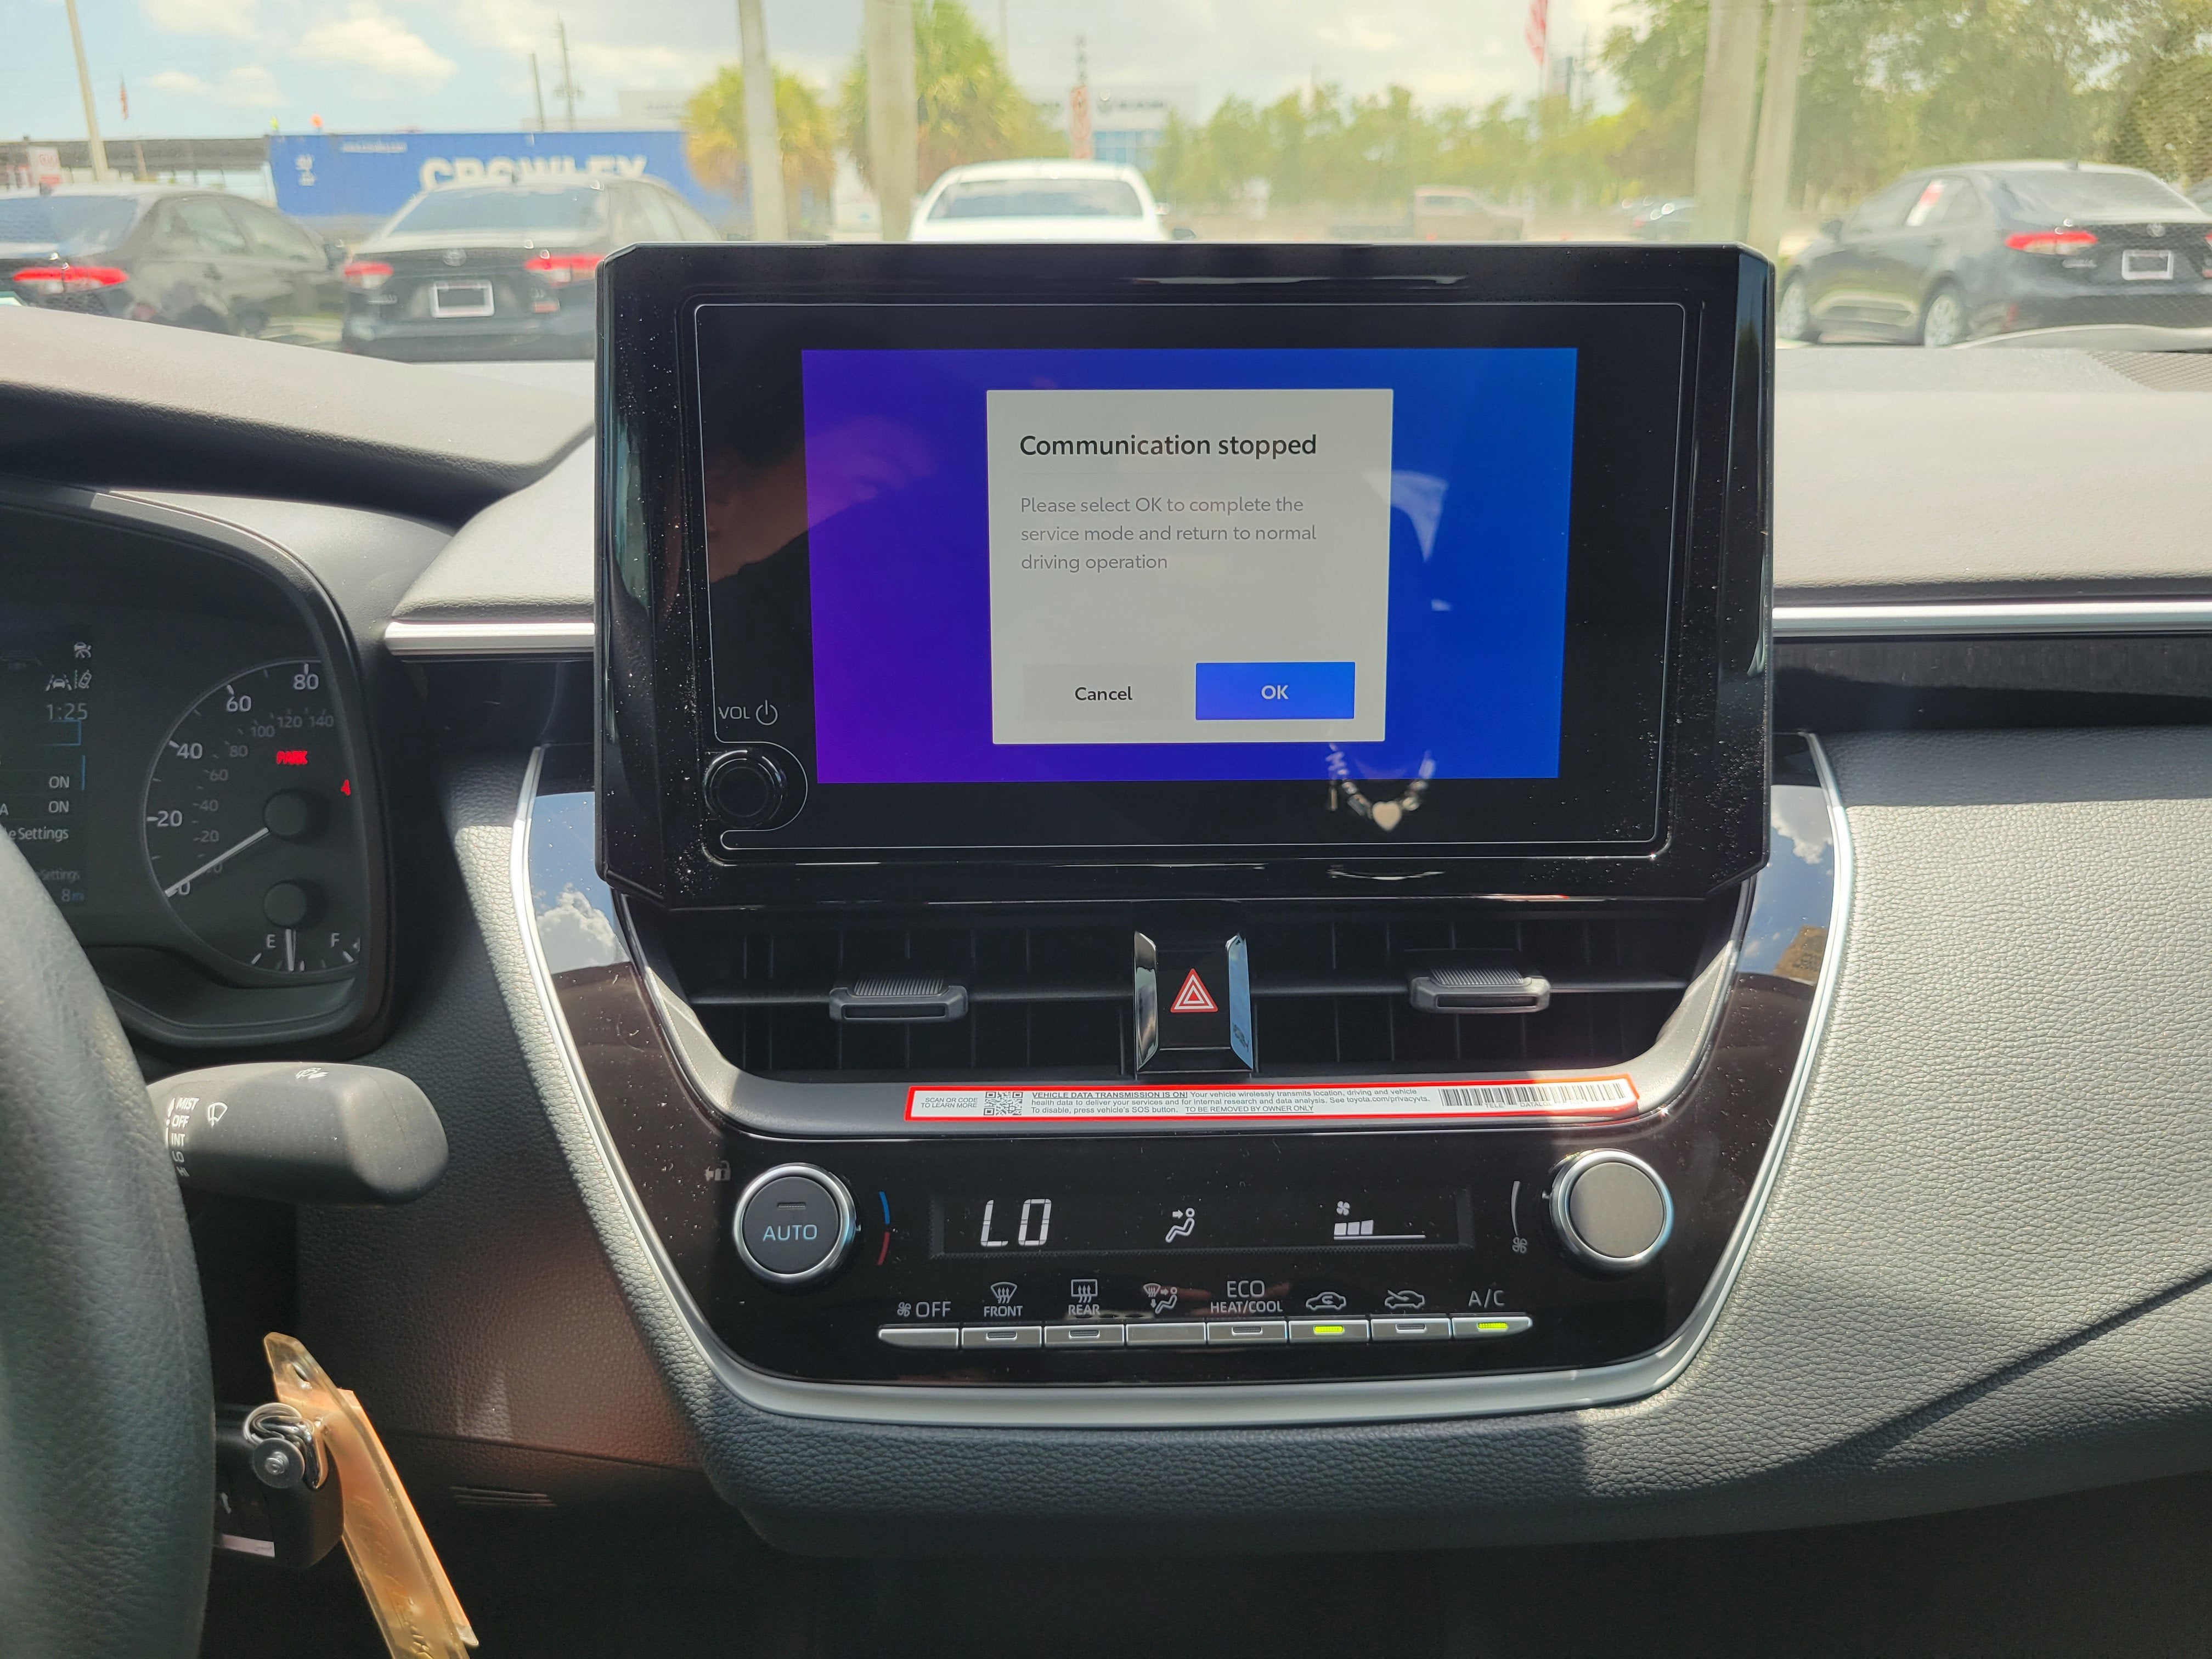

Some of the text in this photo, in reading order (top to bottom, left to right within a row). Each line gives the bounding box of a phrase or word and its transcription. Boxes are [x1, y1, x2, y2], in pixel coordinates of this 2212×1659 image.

[1020, 435, 1317, 460] Communication stopped
[1021, 496, 1304, 516] Please select OK to complete the
[1021, 525, 1317, 541] service mode and return to normal
[1022, 554, 1168, 573] driving operation
[293, 673, 319, 690] 80
[1074, 686, 1133, 702] Cancel
[1261, 685, 1289, 701] OK
[226, 695, 252, 712] 60
[47, 703, 88, 720] 1:25
[718, 706, 751, 719] VOL
[277, 715, 302, 729] 120
[309, 715, 335, 727] 140
[250, 725, 275, 738] 100
[176, 743, 203, 760] 40
[229, 744, 248, 758] 80
[276, 751, 308, 765] PARK
[48, 776, 70, 788] ON
[210, 769, 229, 782] 60
[48, 800, 70, 813] ON
[199, 799, 218, 812] 40
[157, 810, 183, 827] 20
[18, 825, 69, 842] Settings
[200, 830, 220, 843] 20
[178, 881, 191, 895] 0
[266, 934, 276, 949] E
[330, 933, 341, 947] F
[176, 1097, 200, 1110] MIST
[1347, 1095, 1431, 1104] toyota.com/privacyvts.
[171, 1115, 190, 1129] OFF
[171, 1133, 186, 1147] INT
[980, 1198, 1052, 1248] LO
[762, 1223, 818, 1242] AUTO
[1226, 1279, 1265, 1298] ECO
[1468, 1289, 1505, 1308] A/C
[915, 1301, 952, 1317] OFF
[983, 1305, 1024, 1317] FRONT
[1068, 1304, 1101, 1316] REAR
[1210, 1301, 1283, 1314] HEAT/COOL
